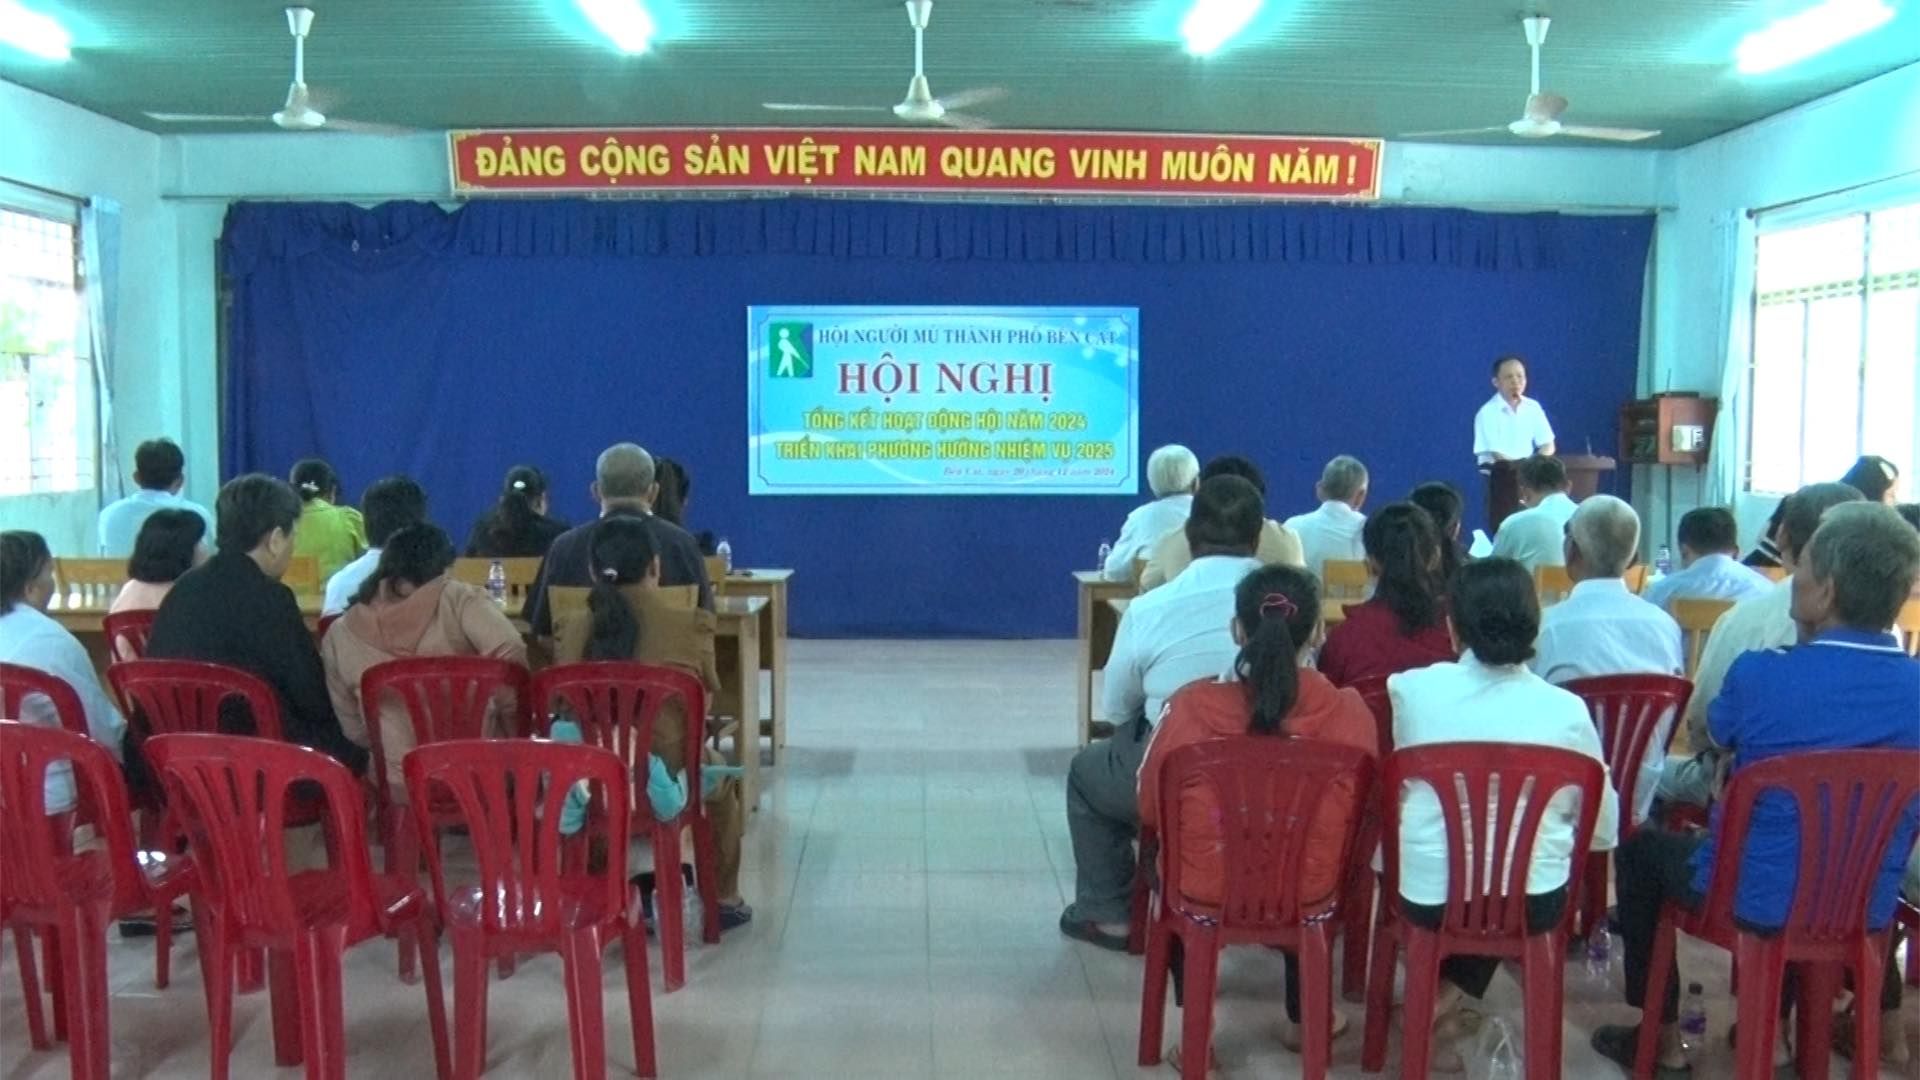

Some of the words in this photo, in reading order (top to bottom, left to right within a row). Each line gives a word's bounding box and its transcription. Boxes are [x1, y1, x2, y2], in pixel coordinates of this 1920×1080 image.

[475, 135, 566, 177] ĐẢNG
[580, 137, 671, 184] CỘNG
[684, 134, 750, 176] SẢN
[764, 137, 839, 184] VIỆT
[854, 144, 926, 176] NAM
[940, 146, 1055, 179] QUANG
[1069, 148, 1147, 180] VINH
[1161, 143, 1255, 182] MUÔN
[1268, 146, 1339, 184] NĂM
[1346, 155, 1357, 184] !
[819, 325, 848, 347] HỘI
[854, 324, 908, 344] NGƯỜI
[914, 324, 939, 344] MÙ
[943, 325, 1001, 344] THÀNH
[1007, 325, 1042, 344] PHỐ
[837, 352, 920, 403] HỘI
[935, 361, 1053, 403] NGHỊ
[803, 406, 845, 430] TỔNG
[848, 406, 880, 429] KẾT
[882, 411, 924, 432] HOẠT
[926, 407, 972, 432] ĐỘNG
[974, 408, 1003, 433] HỘI
[1006, 408, 1044, 430] NĂM
[1048, 411, 1088, 430] 2024
[775, 434, 822, 459] TRIỂN
[825, 441, 863, 459] KHAI
[866, 440, 933, 459] PHƯƠNG
[936, 438, 991, 459] HƯỚNG
[994, 438, 1048, 463] NHIỆM
[1050, 441, 1072, 463] VỤ
[1075, 441, 1115, 460] 2025
